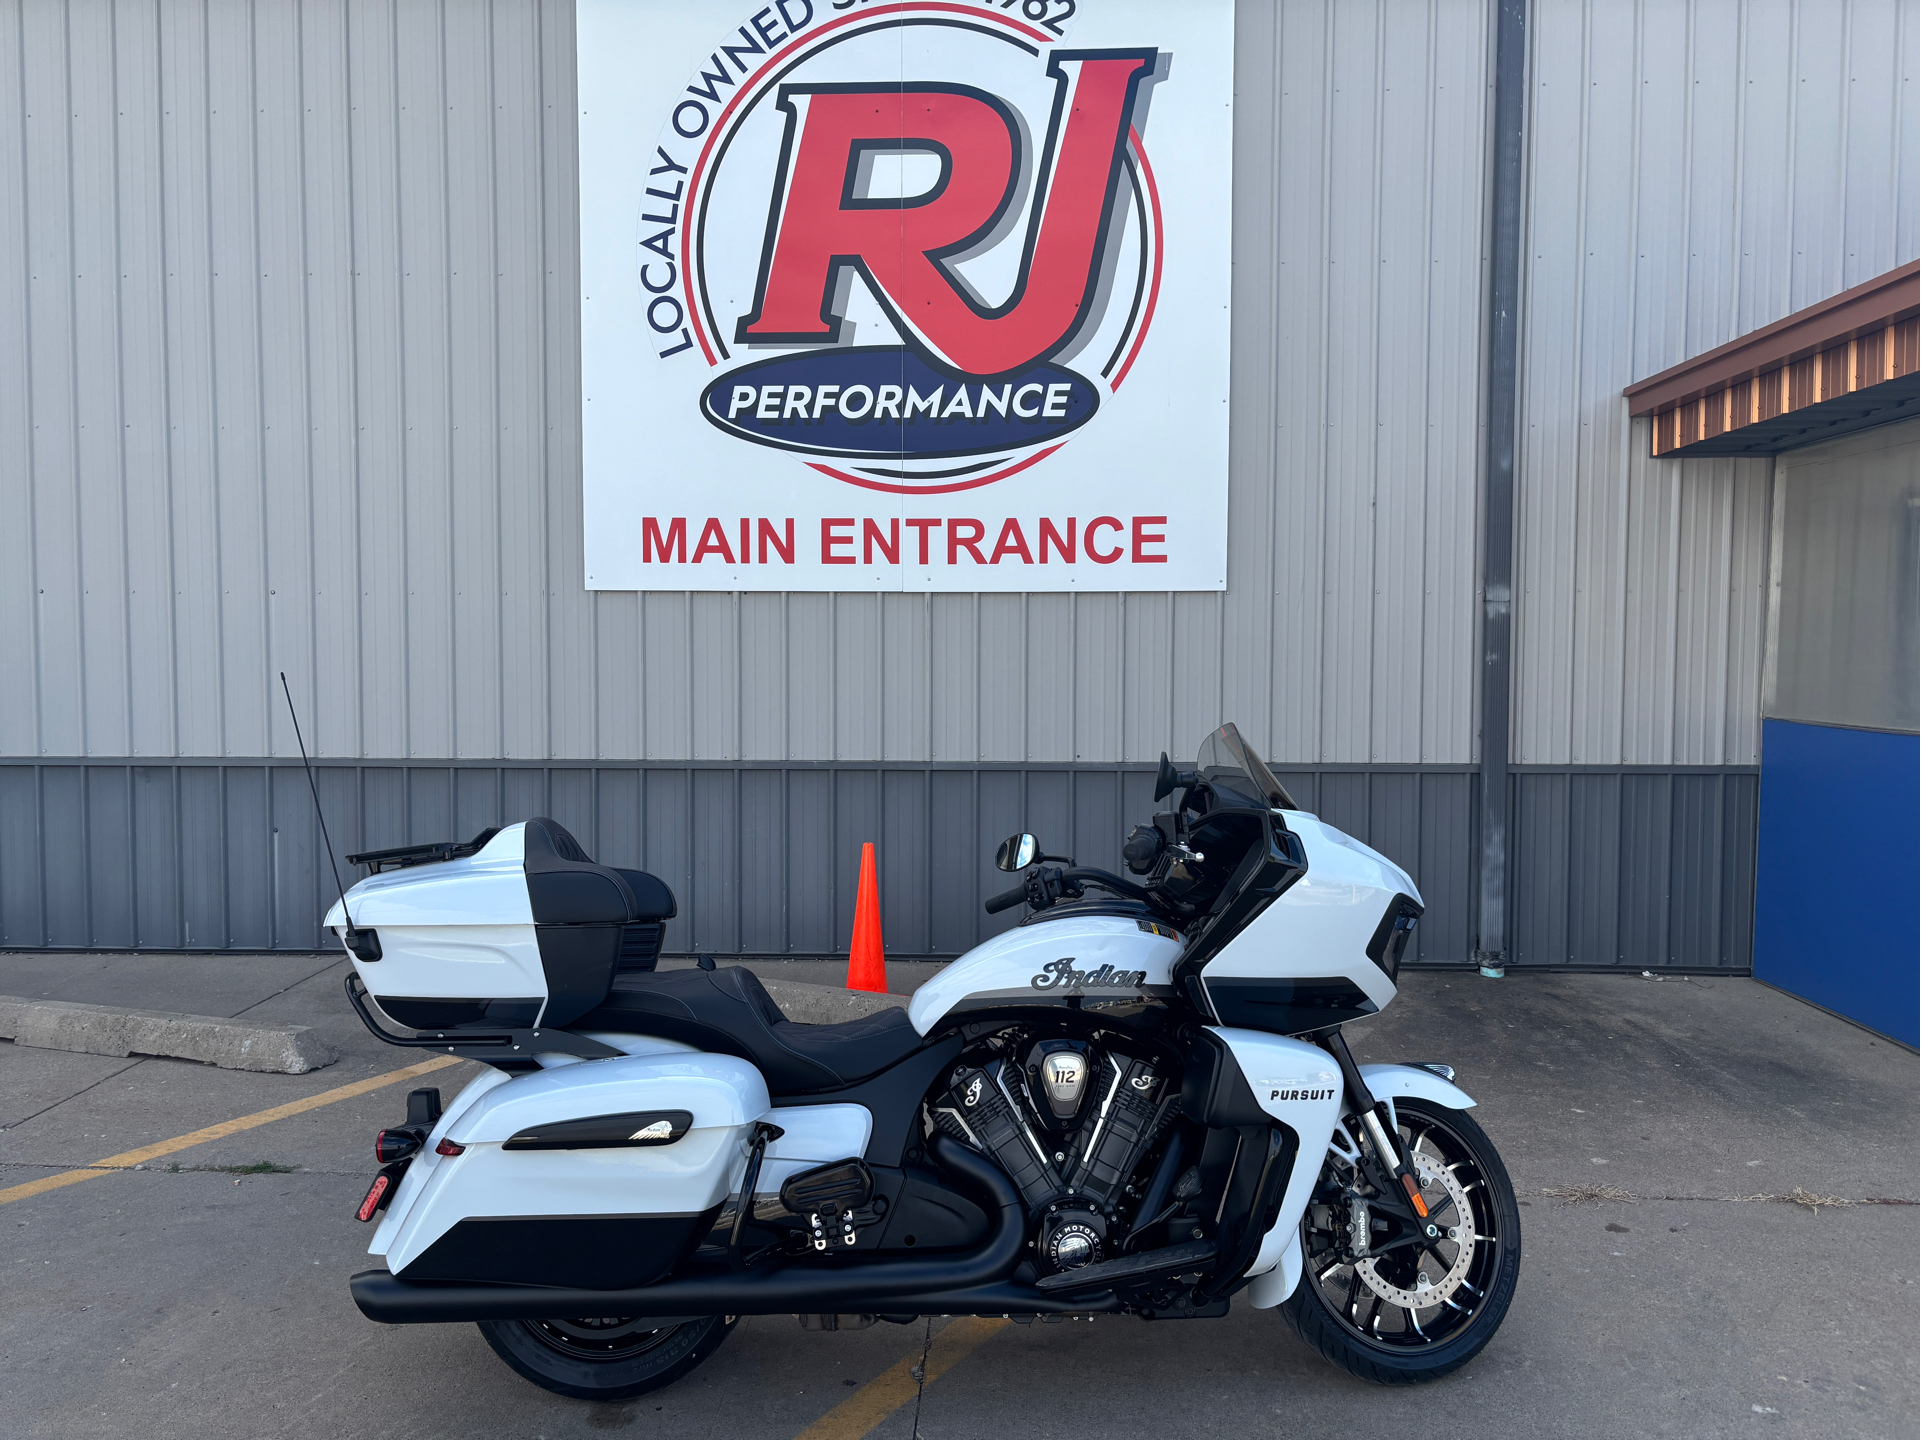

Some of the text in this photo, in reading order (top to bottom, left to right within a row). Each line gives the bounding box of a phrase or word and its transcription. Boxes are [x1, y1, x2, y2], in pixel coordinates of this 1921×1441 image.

[638, 145, 694, 359] LOCALLY
[672, 0, 814, 139] OWNED
[733, 47, 1160, 380] RJ
[727, 383, 1072, 419] PERFORMANCE
[641, 516, 1168, 565] MAIN ENTRANCE
[1030, 957, 1147, 991] Indian
[1055, 1070, 1076, 1084] 112
[1270, 1089, 1335, 1101] PURSUIT
[1358, 1211, 1366, 1246] brembo
[1485, 1254, 1515, 1325] METZELER
